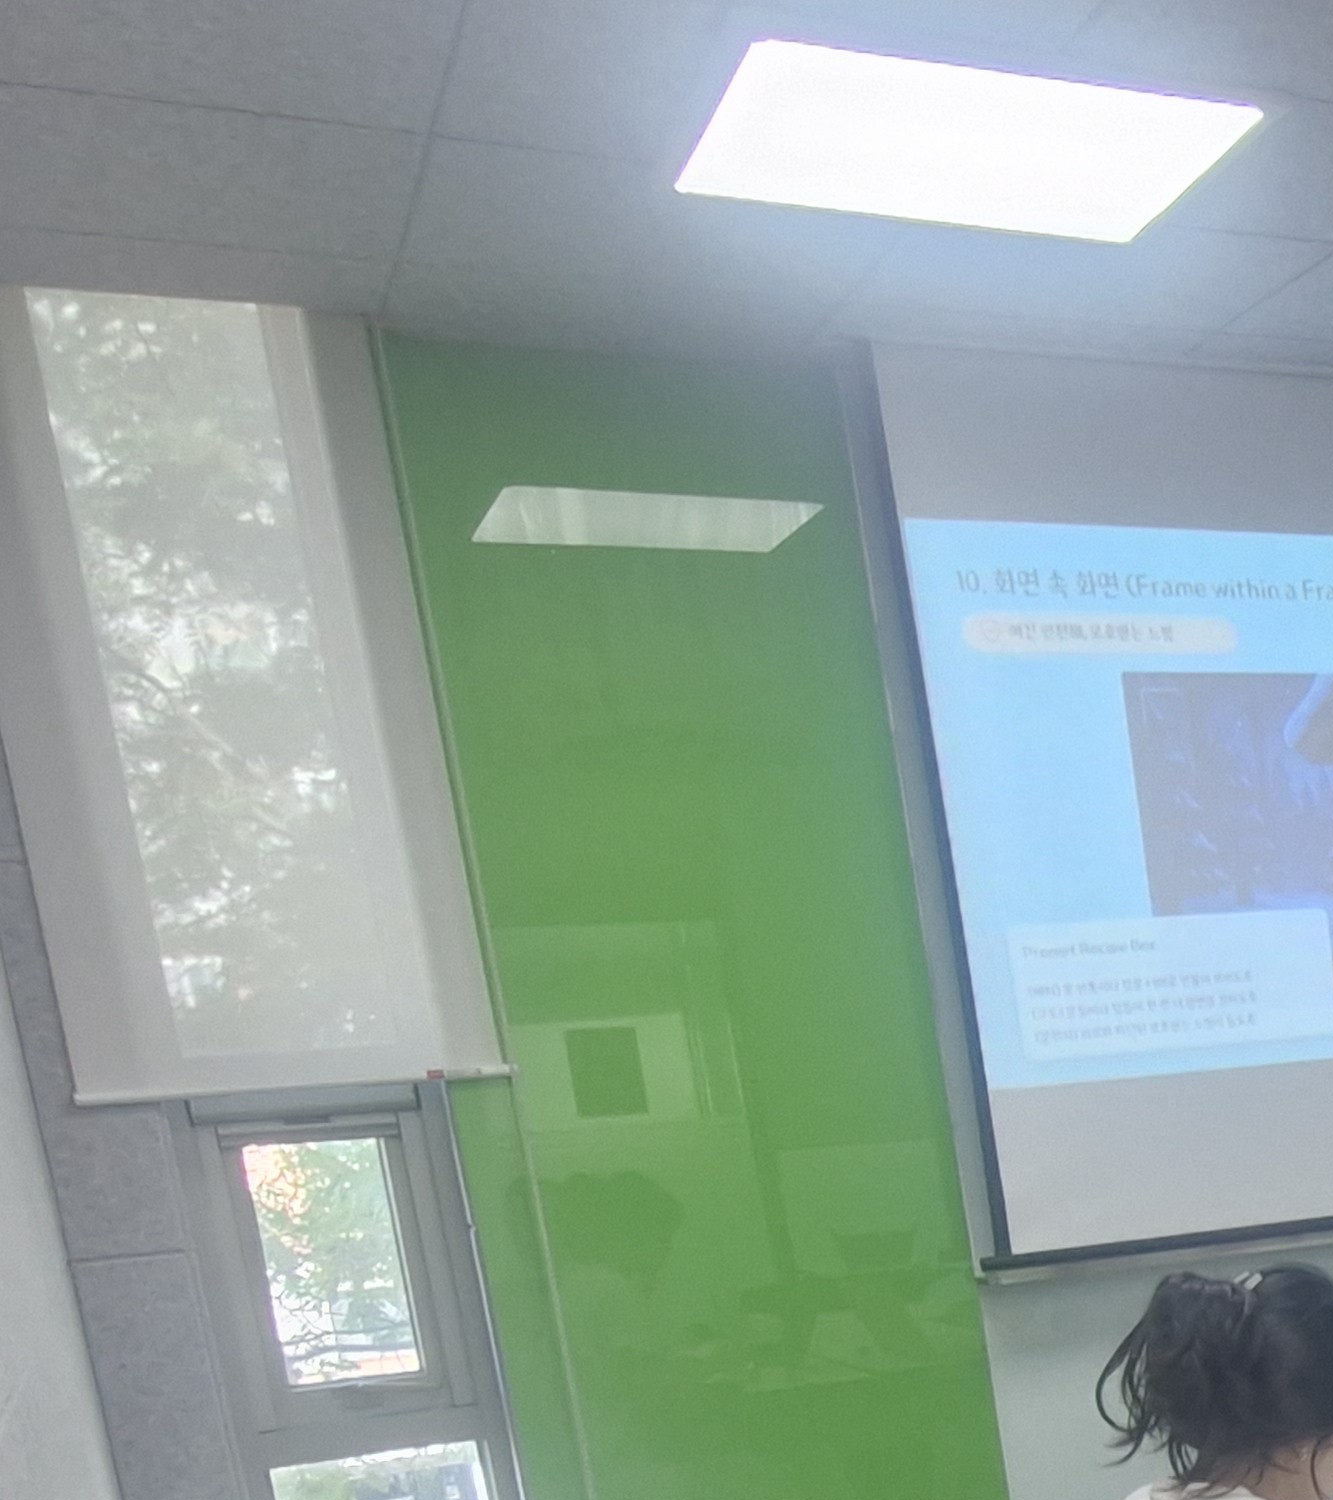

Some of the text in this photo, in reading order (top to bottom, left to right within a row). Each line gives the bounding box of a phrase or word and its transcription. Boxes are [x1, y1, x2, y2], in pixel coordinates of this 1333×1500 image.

[956, 569, 987, 595] 10.
[995, 568, 1041, 598] 화면
[1050, 568, 1069, 599] 속
[1076, 569, 1119, 600] 화면
[1124, 571, 1207, 601] (Frame
[1211, 577, 1280, 600] within
[1285, 582, 1298, 601] a
